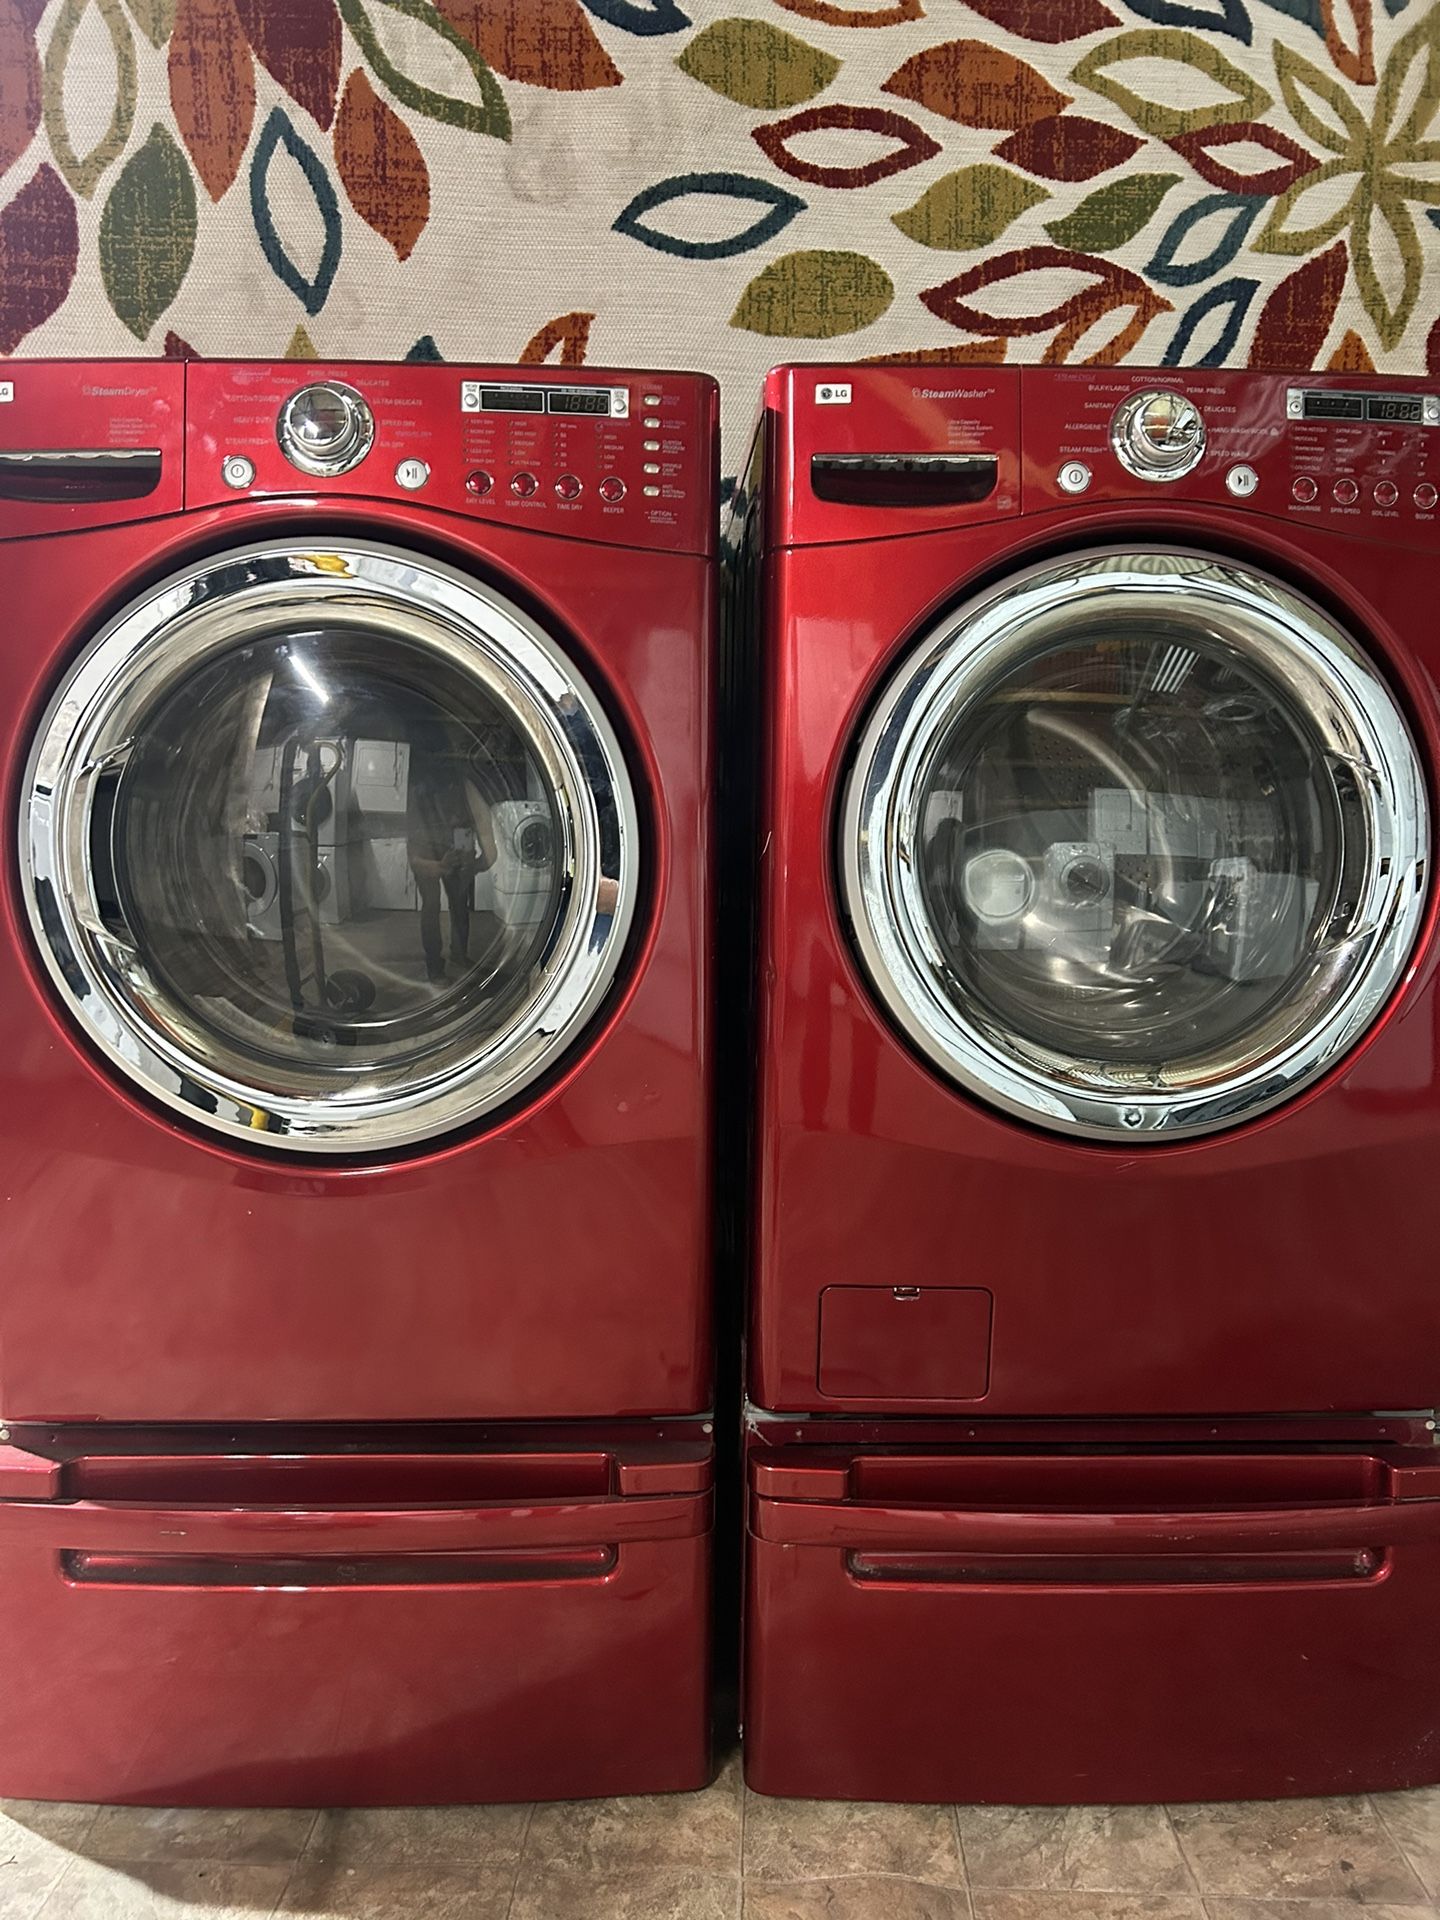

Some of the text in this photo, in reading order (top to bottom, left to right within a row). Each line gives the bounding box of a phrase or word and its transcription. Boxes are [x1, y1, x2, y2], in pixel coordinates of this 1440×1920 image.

[835, 389, 847, 398] LG
[479, 497, 496, 505] LEVEL
[505, 500, 547, 509] TEMP CONTROL
[557, 503, 570, 511] TIME
[603, 506, 624, 514] BEEPER
